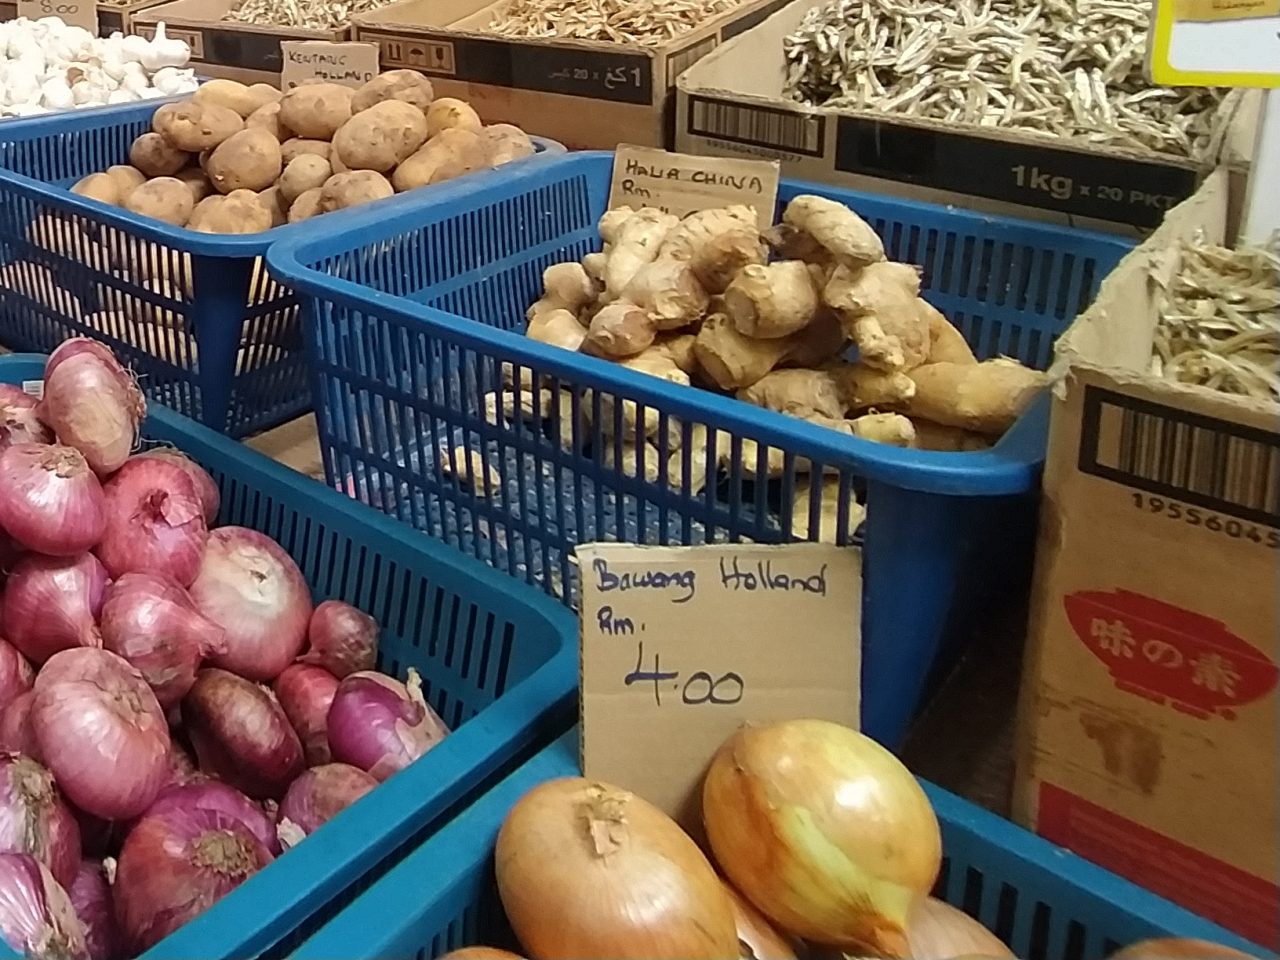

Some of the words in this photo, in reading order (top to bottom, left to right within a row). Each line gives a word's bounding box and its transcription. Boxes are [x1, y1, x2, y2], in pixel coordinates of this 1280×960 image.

[690, 170, 763, 195] CHINA
[1011, 164, 1074, 200] 1kg
[1096, 184, 1122, 202] 20
[592, 557, 697, 603] Bawang
[719, 555, 828, 597] Holland
[623, 640, 745, 707] 4.00
[1090, 616, 1243, 699] 味の素
